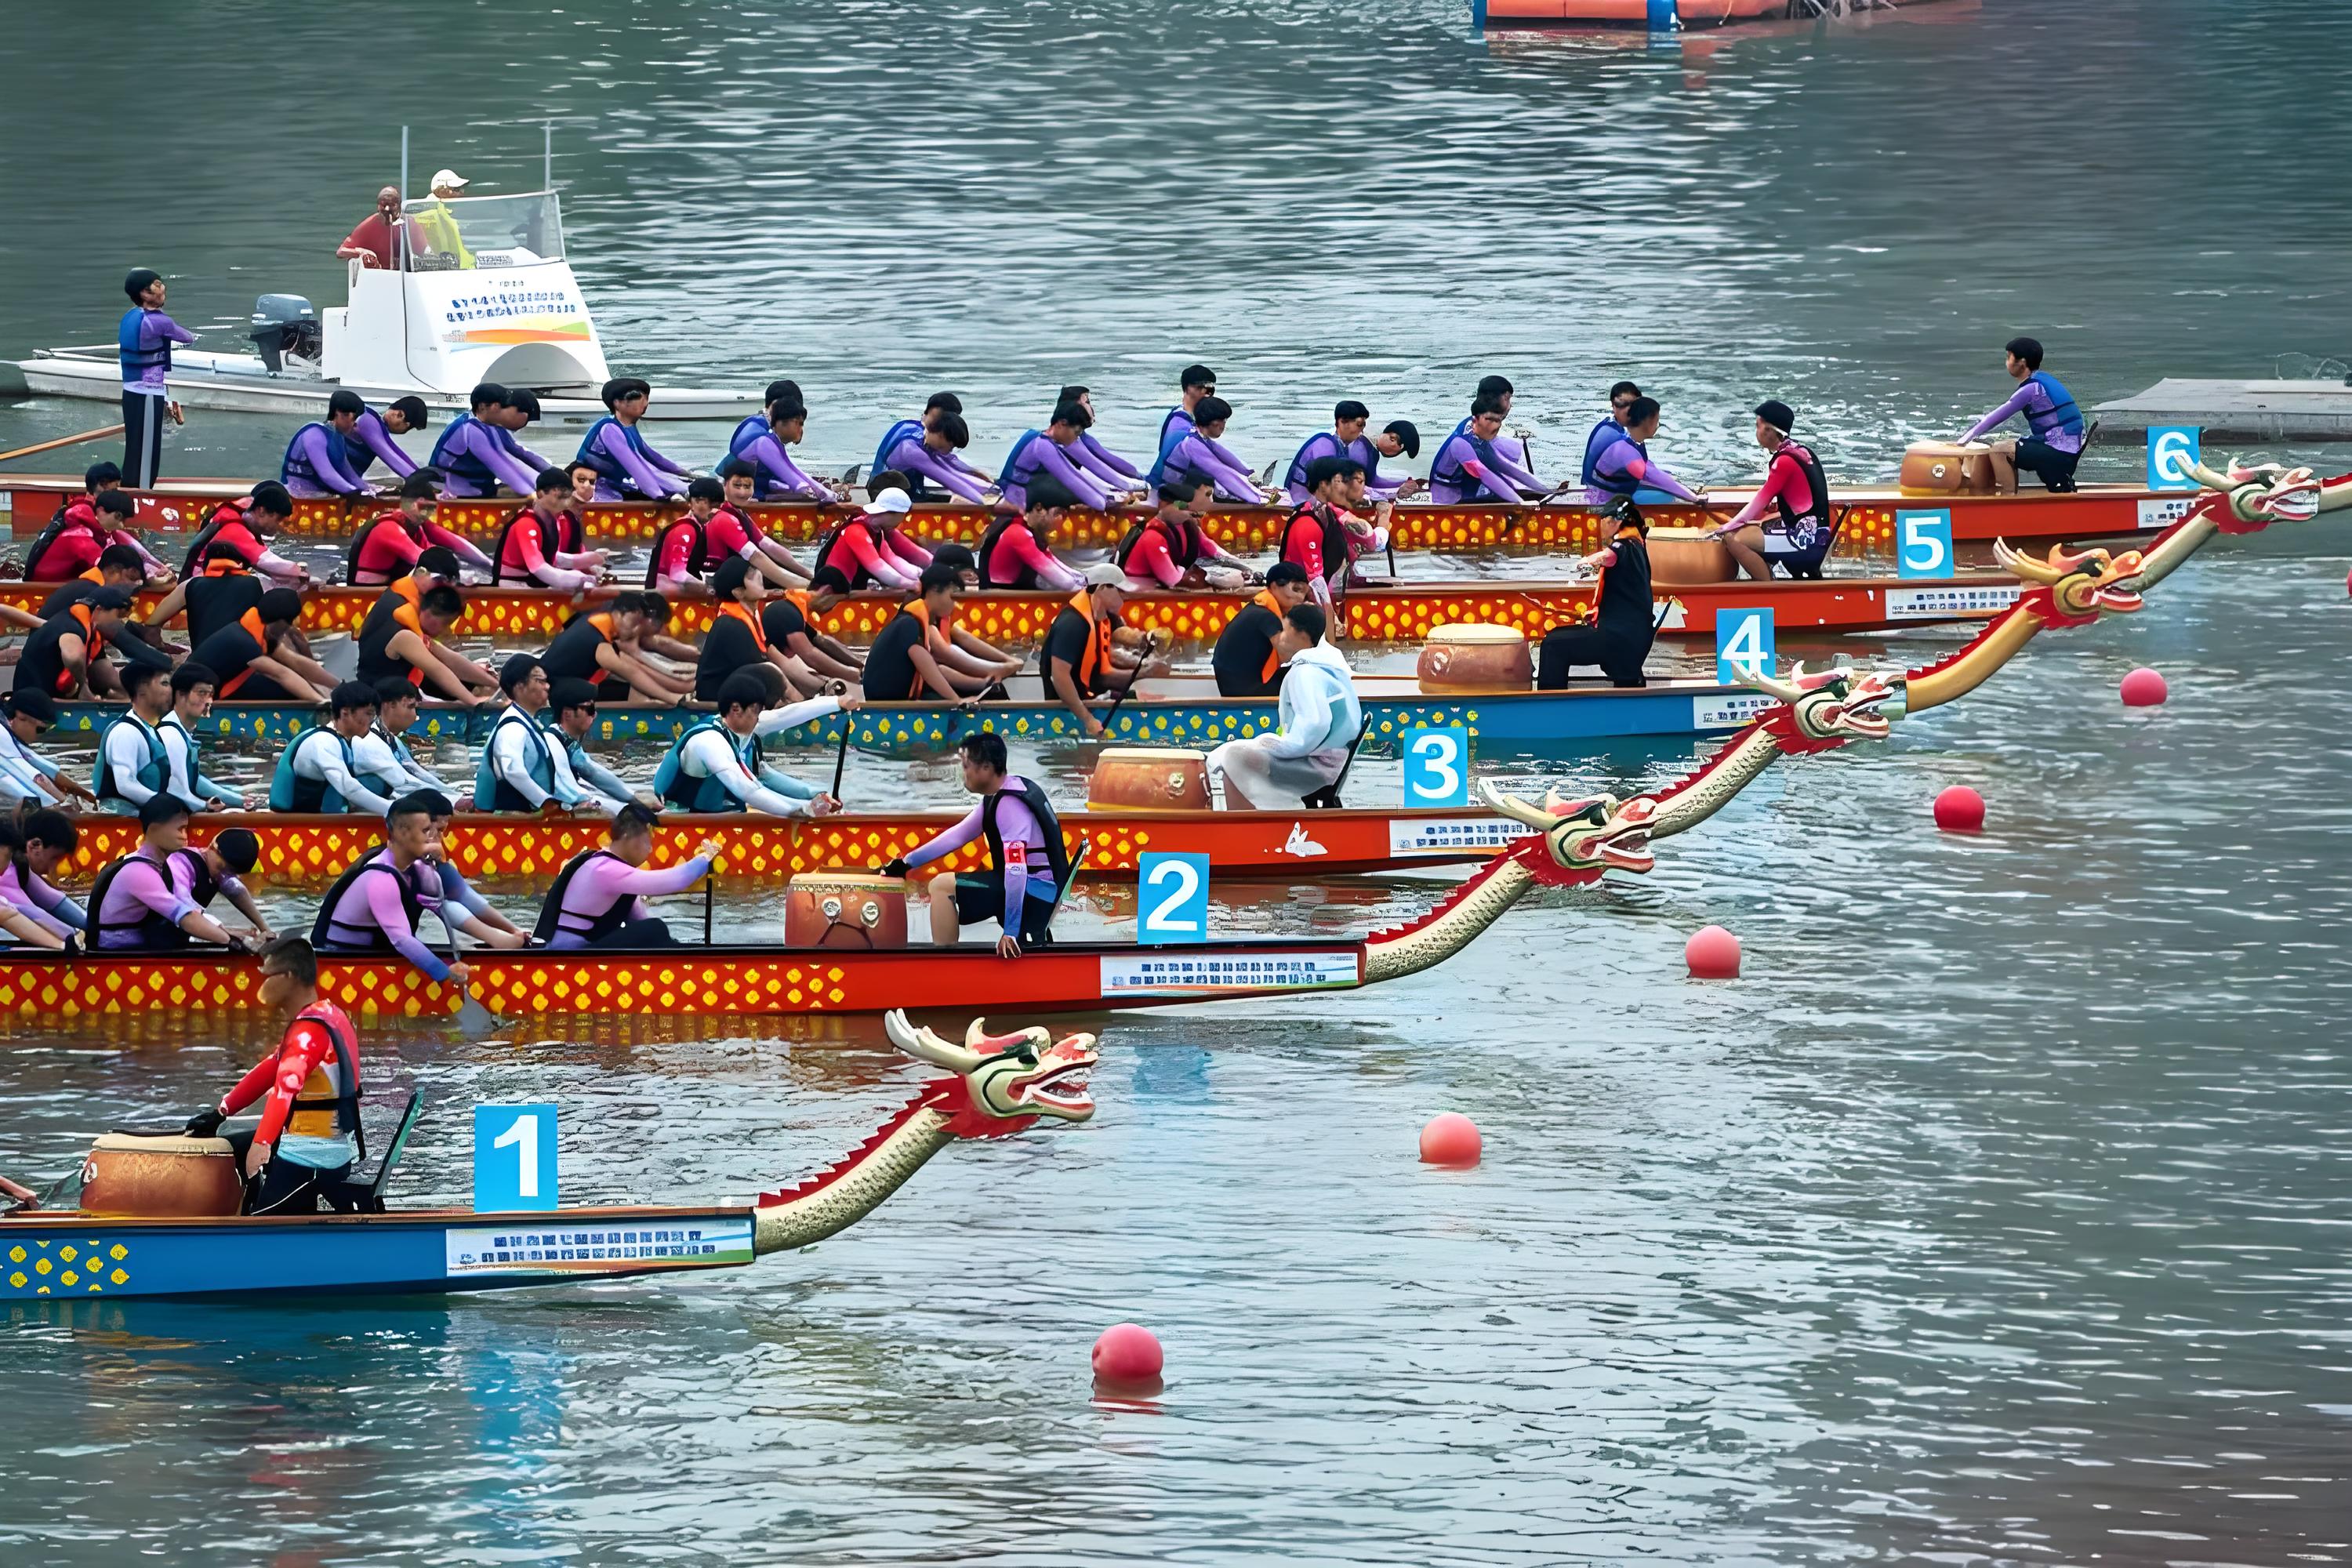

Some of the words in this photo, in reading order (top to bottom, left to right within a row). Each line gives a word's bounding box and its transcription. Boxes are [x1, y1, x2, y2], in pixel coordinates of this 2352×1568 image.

[2154, 431, 2197, 481] 6
[1905, 517, 1944, 570] 5
[1722, 615, 1769, 678] 4
[1412, 735, 1459, 798] 3
[1146, 860, 1199, 931] 2
[494, 1115, 539, 1196] 1
